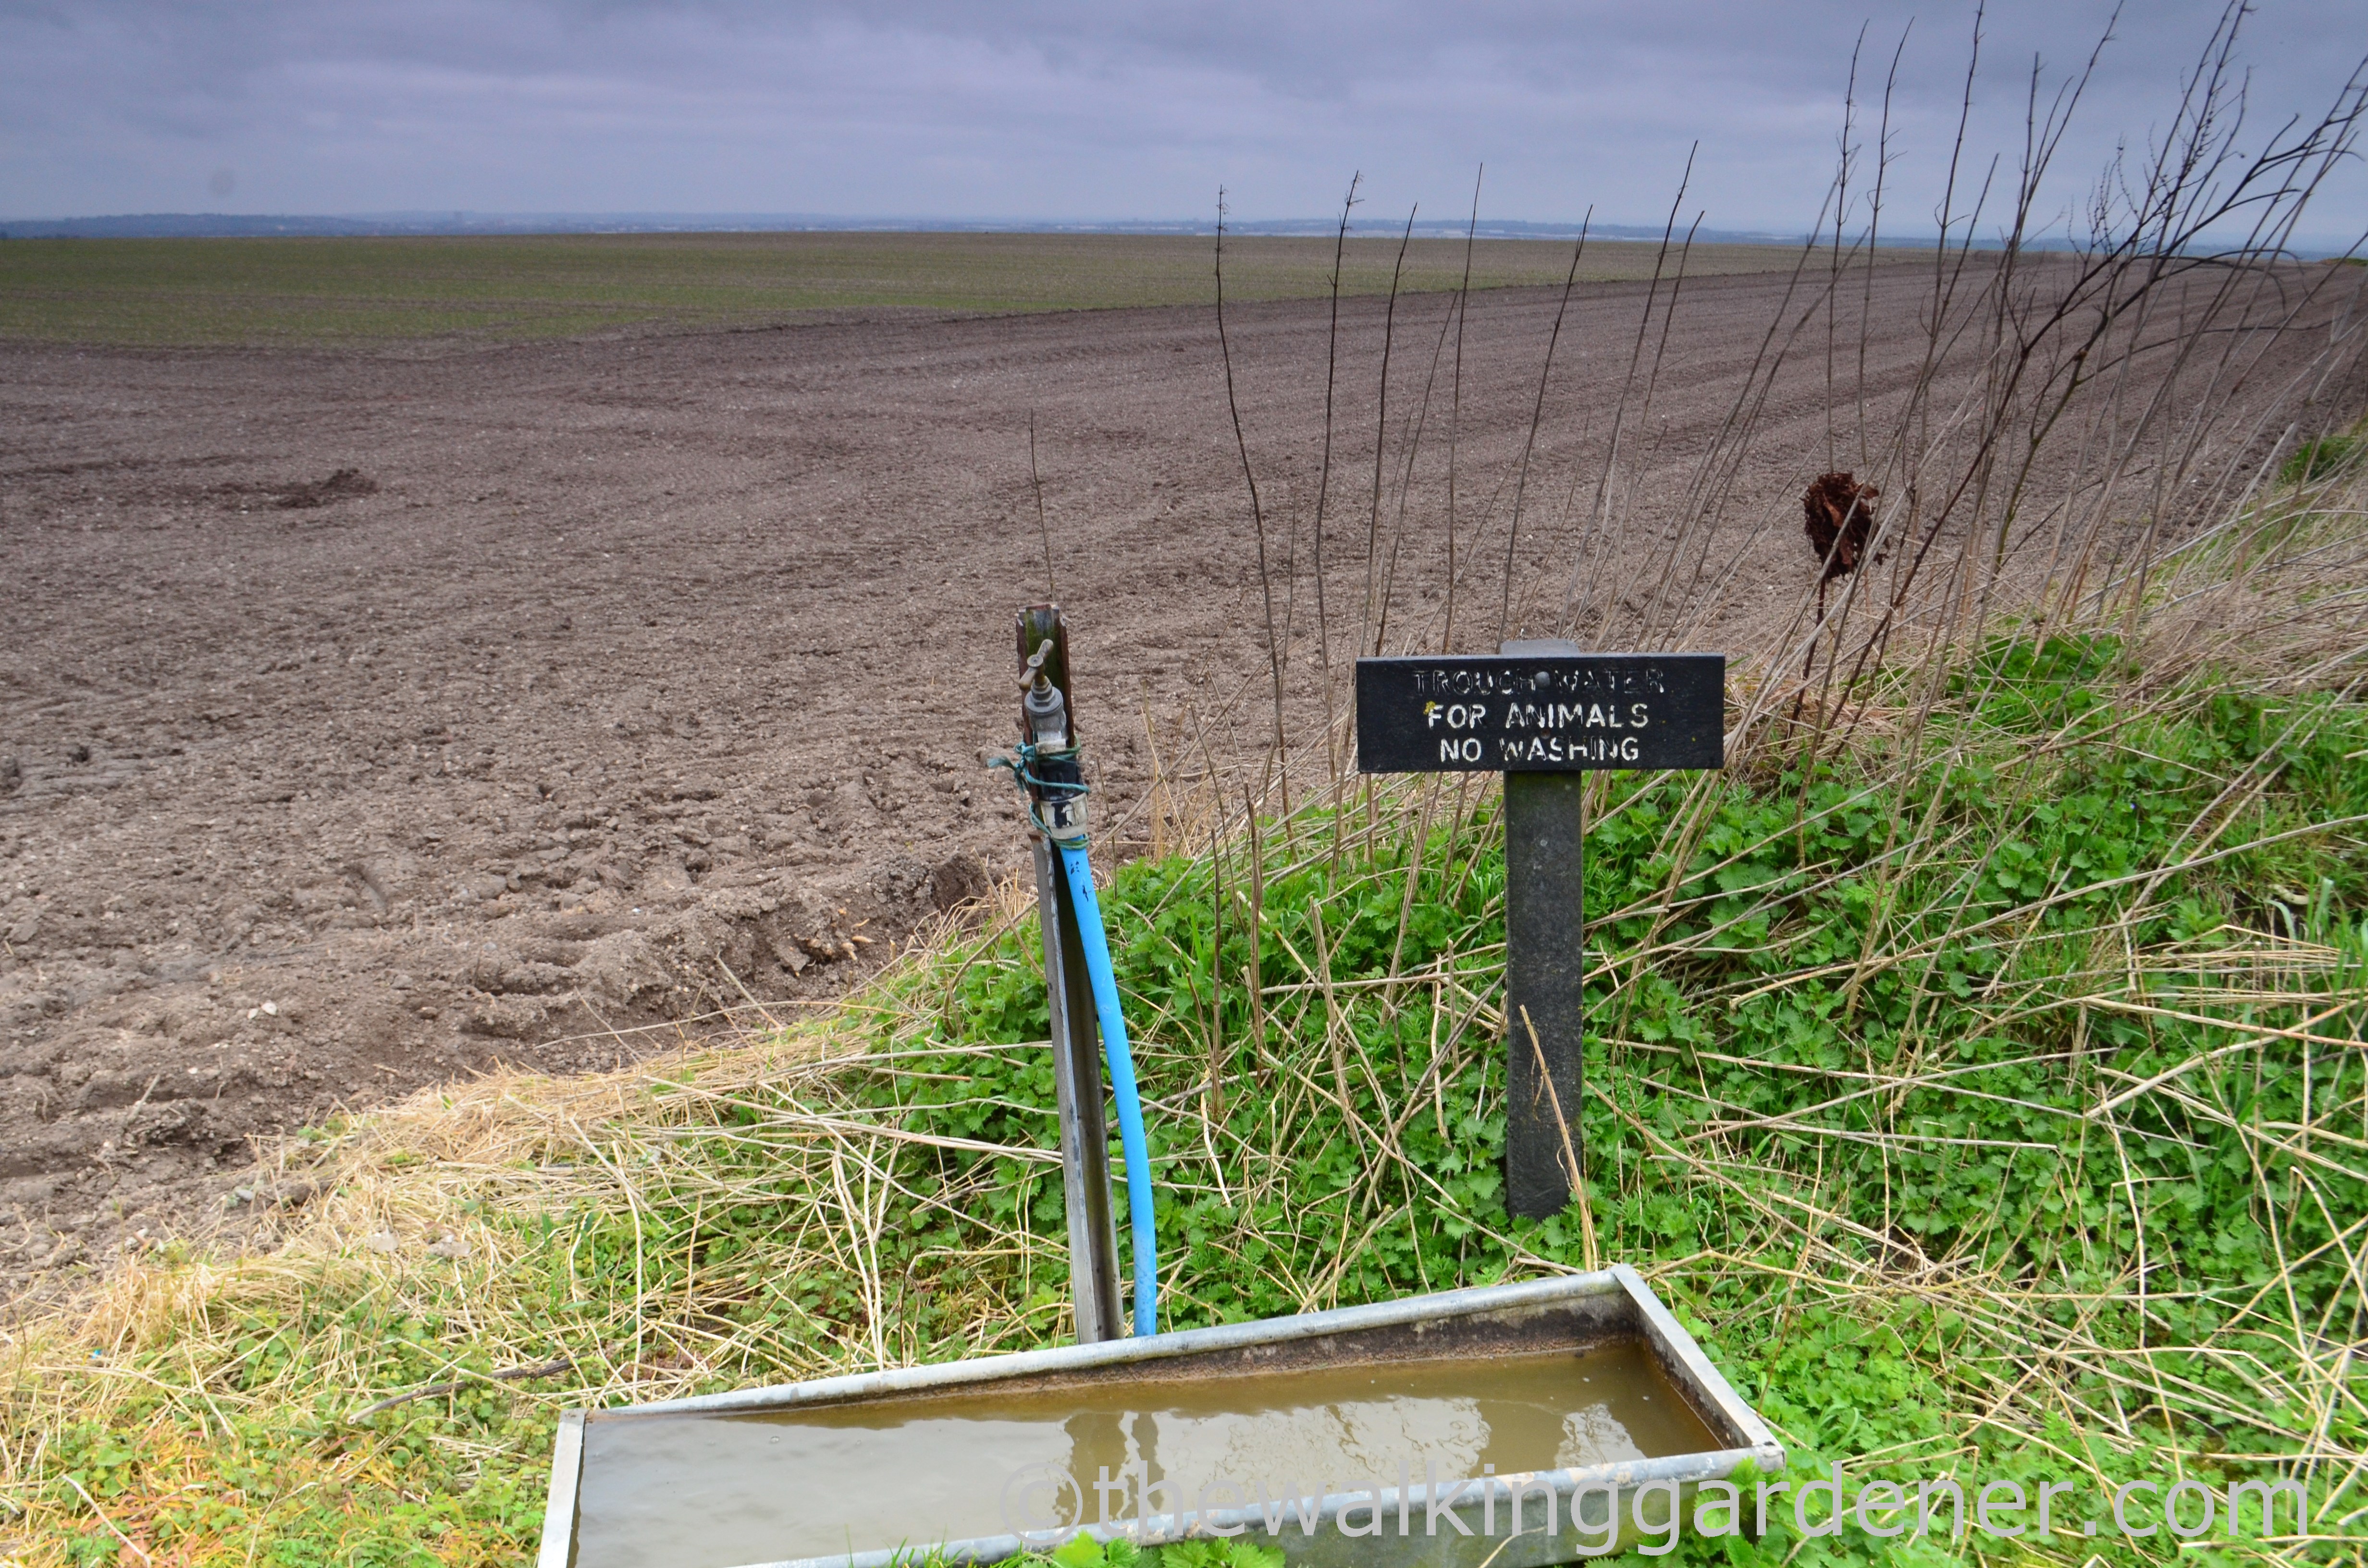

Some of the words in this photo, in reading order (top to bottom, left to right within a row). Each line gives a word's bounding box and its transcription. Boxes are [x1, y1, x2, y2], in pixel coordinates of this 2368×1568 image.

[1554, 669, 1664, 694] WATER
[1427, 703, 1486, 729] FOR
[1505, 702, 1649, 729] ANIMALS
[1440, 737, 1482, 762] NO
[1499, 736, 1639, 761] WASHING
